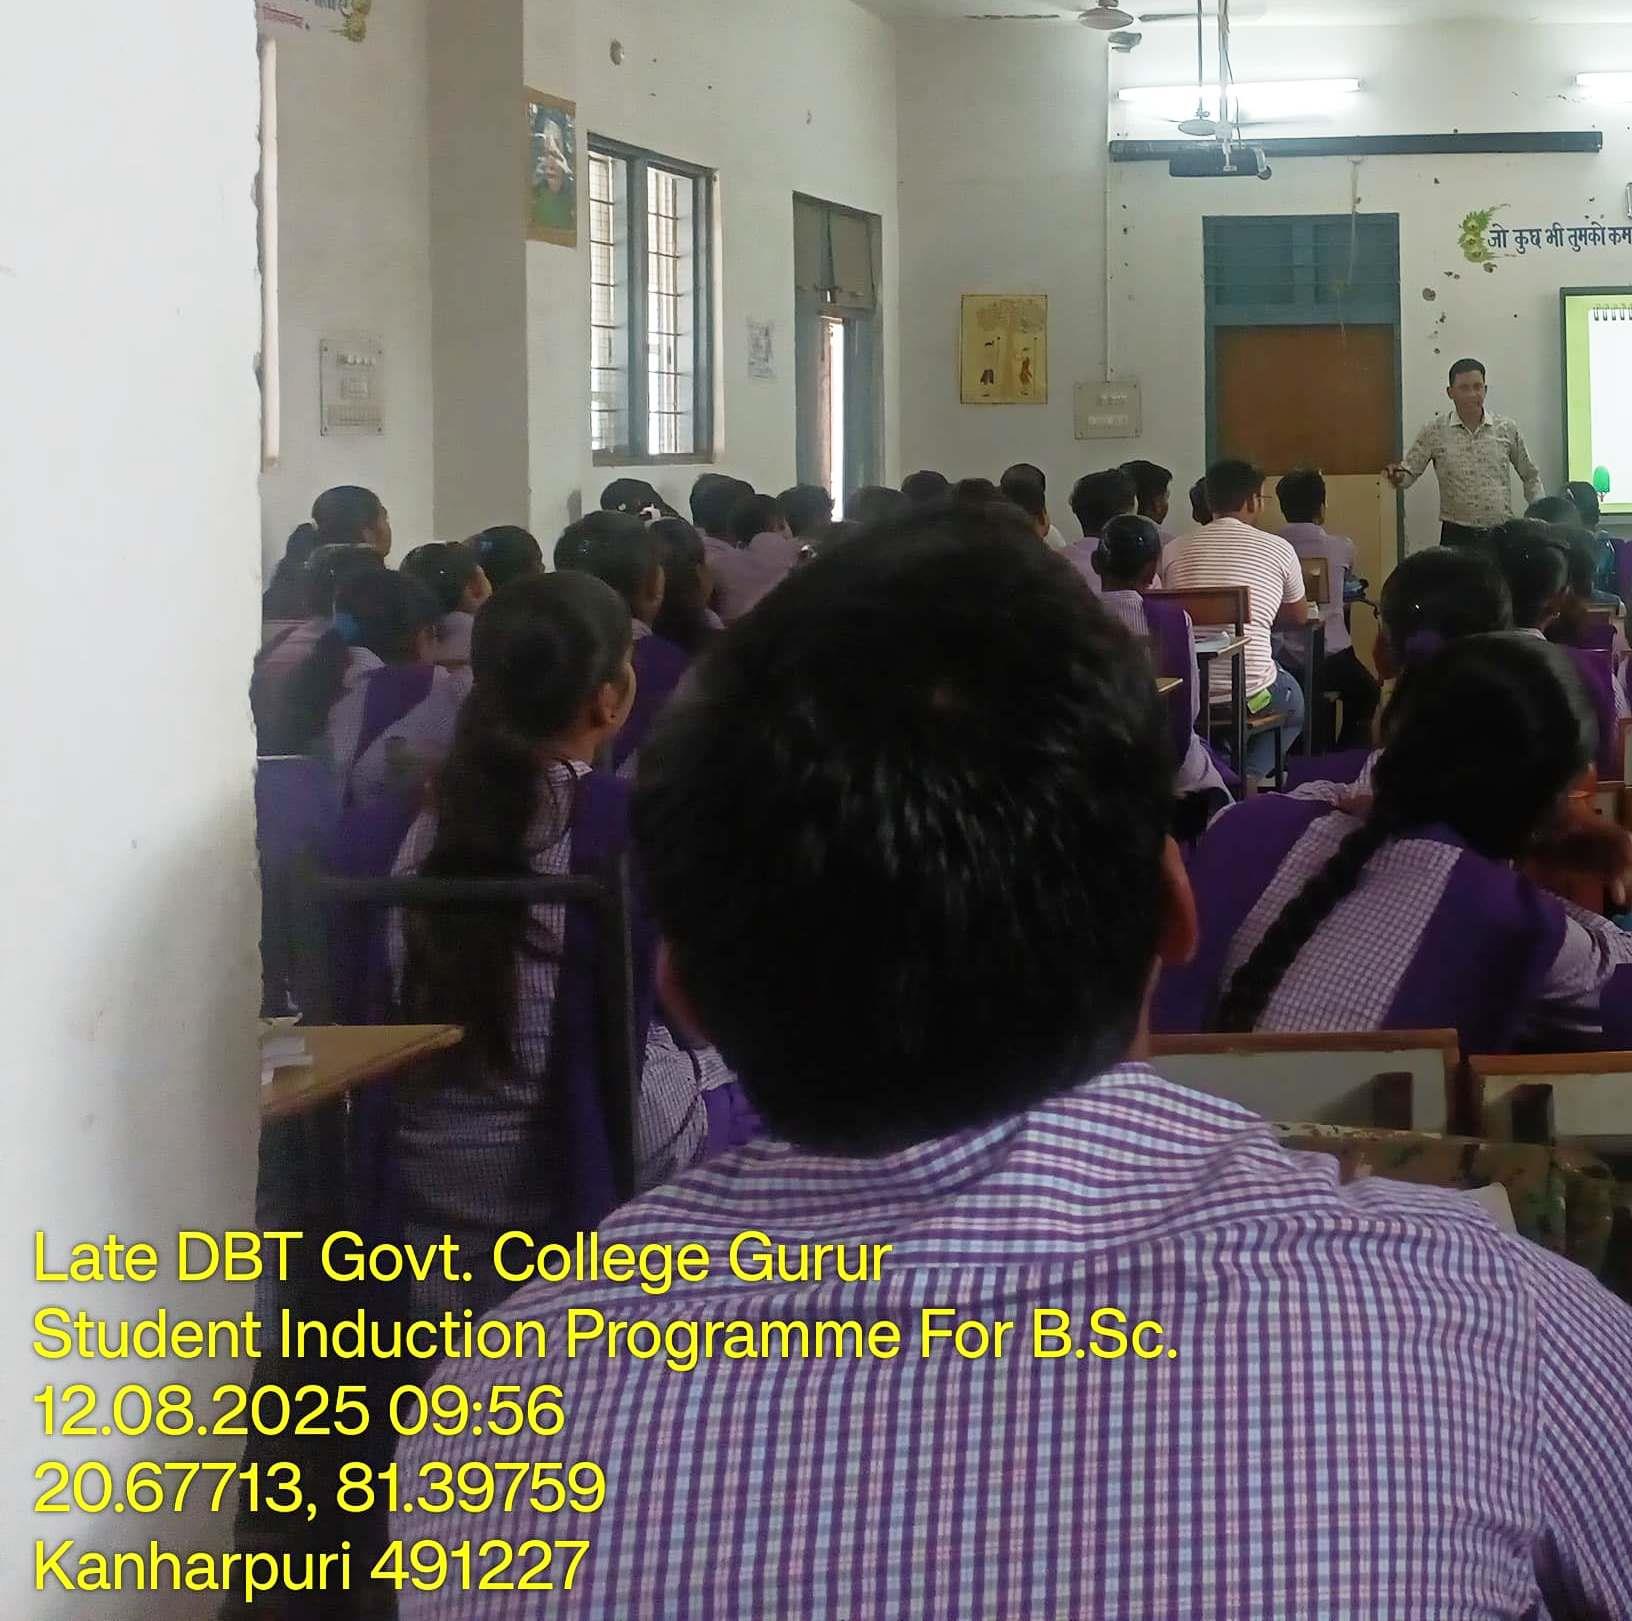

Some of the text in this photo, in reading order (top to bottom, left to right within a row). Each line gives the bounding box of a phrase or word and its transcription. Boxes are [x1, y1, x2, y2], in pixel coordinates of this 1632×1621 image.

[1488, 223, 1509, 248] जो
[1545, 222, 1565, 247] भी
[1566, 221, 1606, 252] तुमको
